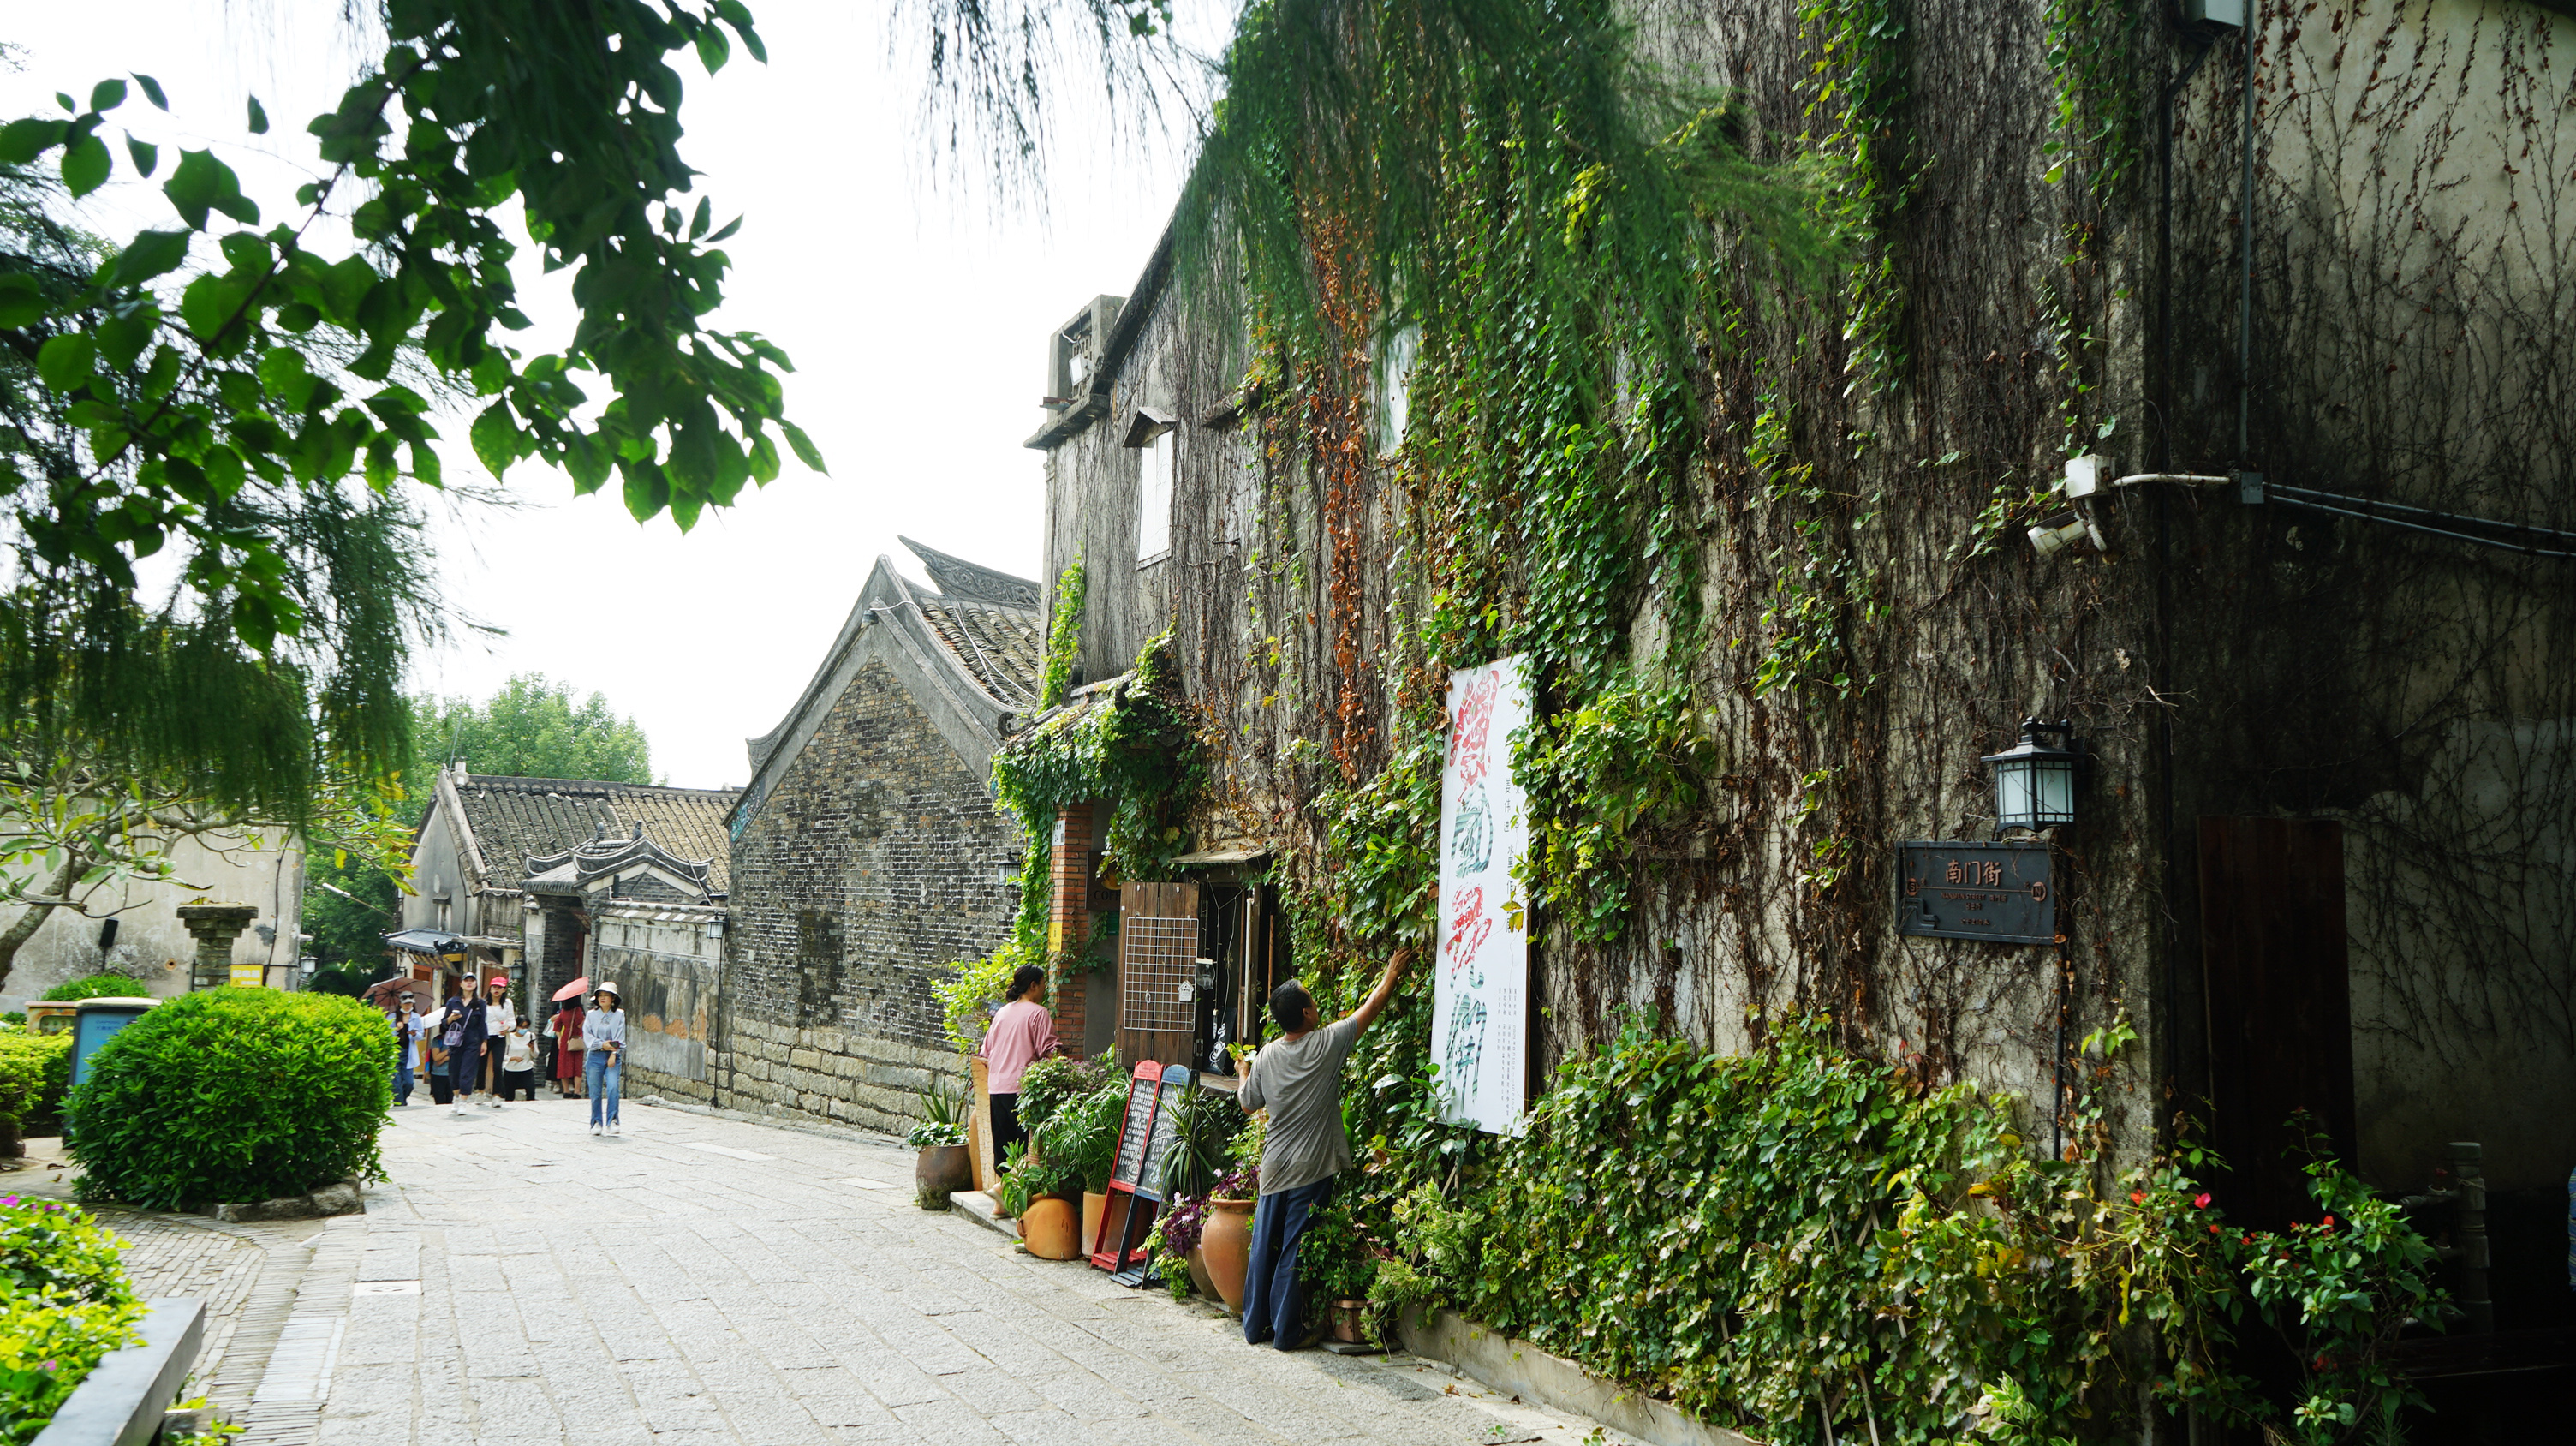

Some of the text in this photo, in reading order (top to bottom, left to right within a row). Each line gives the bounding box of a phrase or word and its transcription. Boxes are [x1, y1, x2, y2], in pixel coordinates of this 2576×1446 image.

[1946, 859, 2003, 887] 南门街
[1965, 893, 1986, 901] STREET
